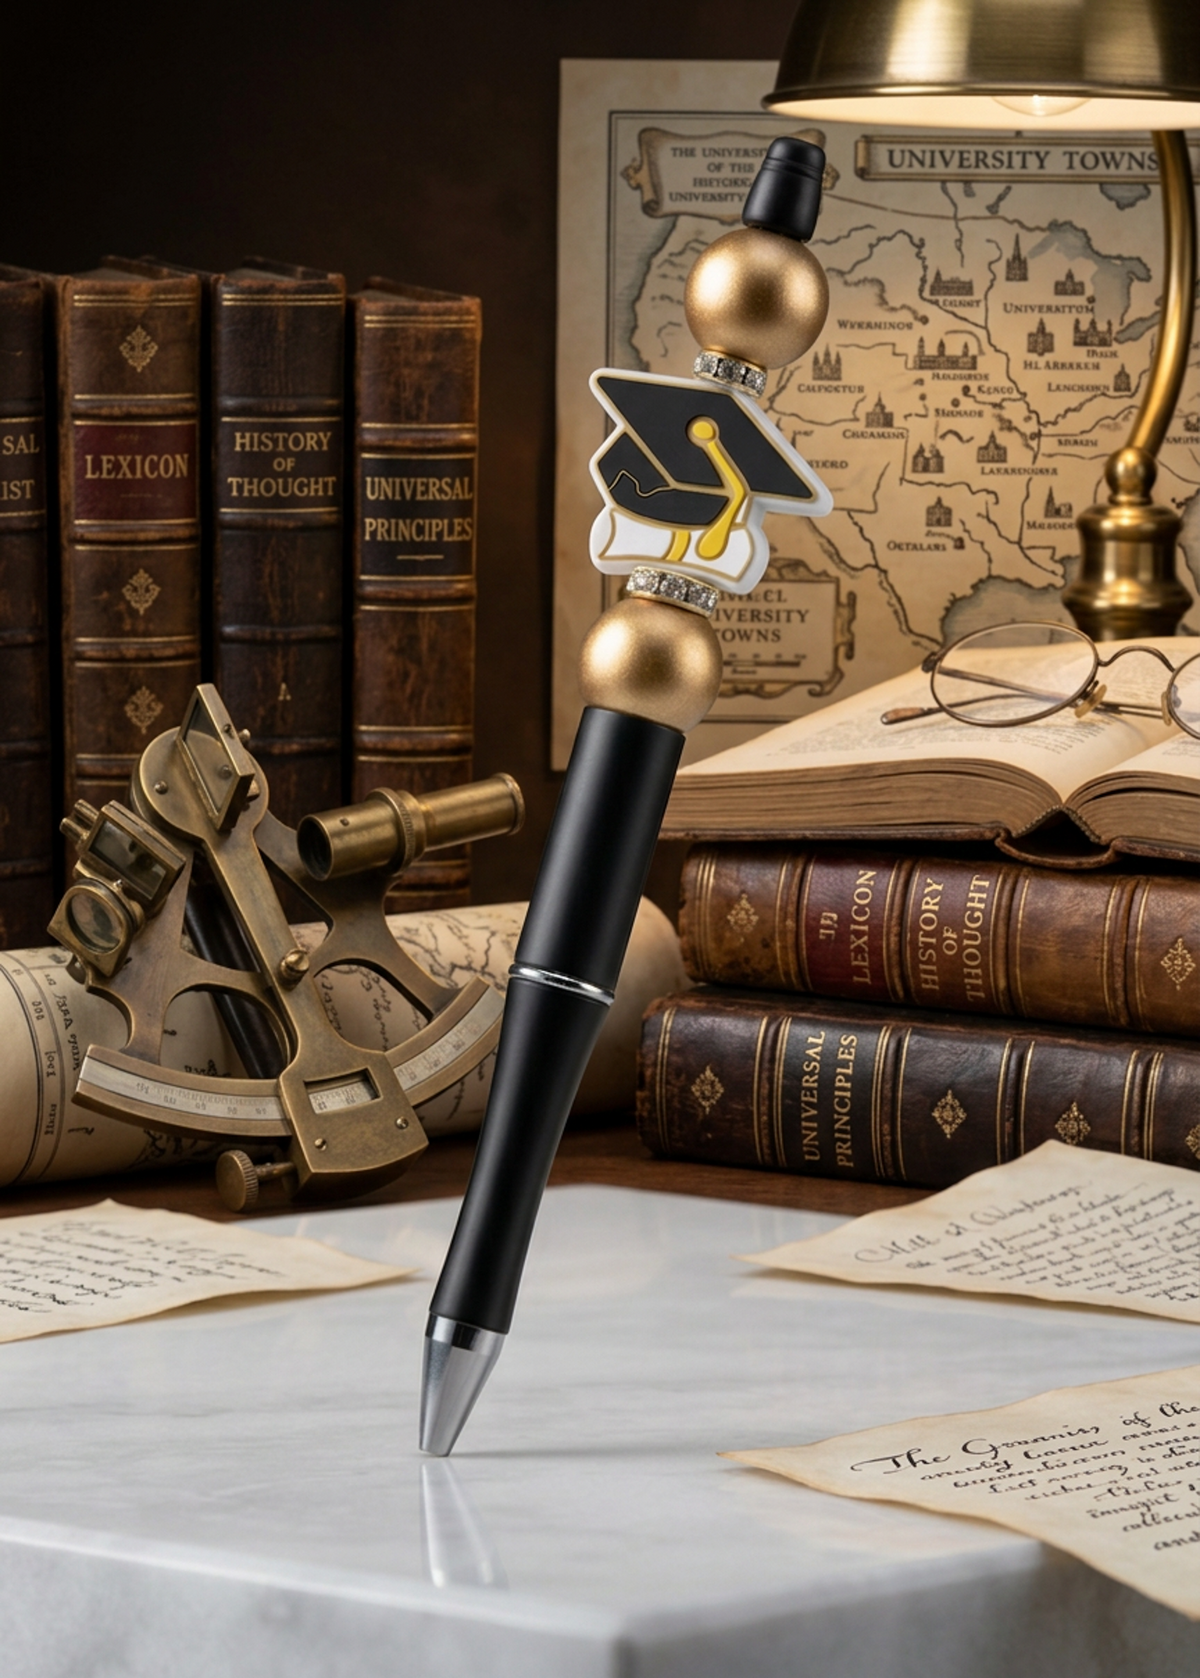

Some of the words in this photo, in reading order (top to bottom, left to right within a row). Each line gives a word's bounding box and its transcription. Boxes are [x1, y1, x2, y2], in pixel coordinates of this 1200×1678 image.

[706, 162, 724, 173] OF
[887, 149, 1050, 170] UNIVERSITY
[1063, 150, 1159, 171] TOWNS
[2, 433, 41, 455] SAL
[233, 431, 333, 452] HISTORY
[84, 453, 190, 480] LEXICON
[272, 456, 296, 472] OF
[226, 475, 338, 497] THOUGHT
[364, 476, 473, 501] UNIVERSAL
[363, 517, 473, 542] PRINCIPLES
[714, 607, 810, 623] IVERSITY
[850, 869, 877, 985] LEXICON
[917, 877, 944, 990] HISTORY
[961, 873, 991, 1002] THOUGHT
[941, 925, 958, 956] OF
[800, 1030, 826, 1162] UNIVERSAL
[832, 1033, 858, 1168] PRINCIPLES
